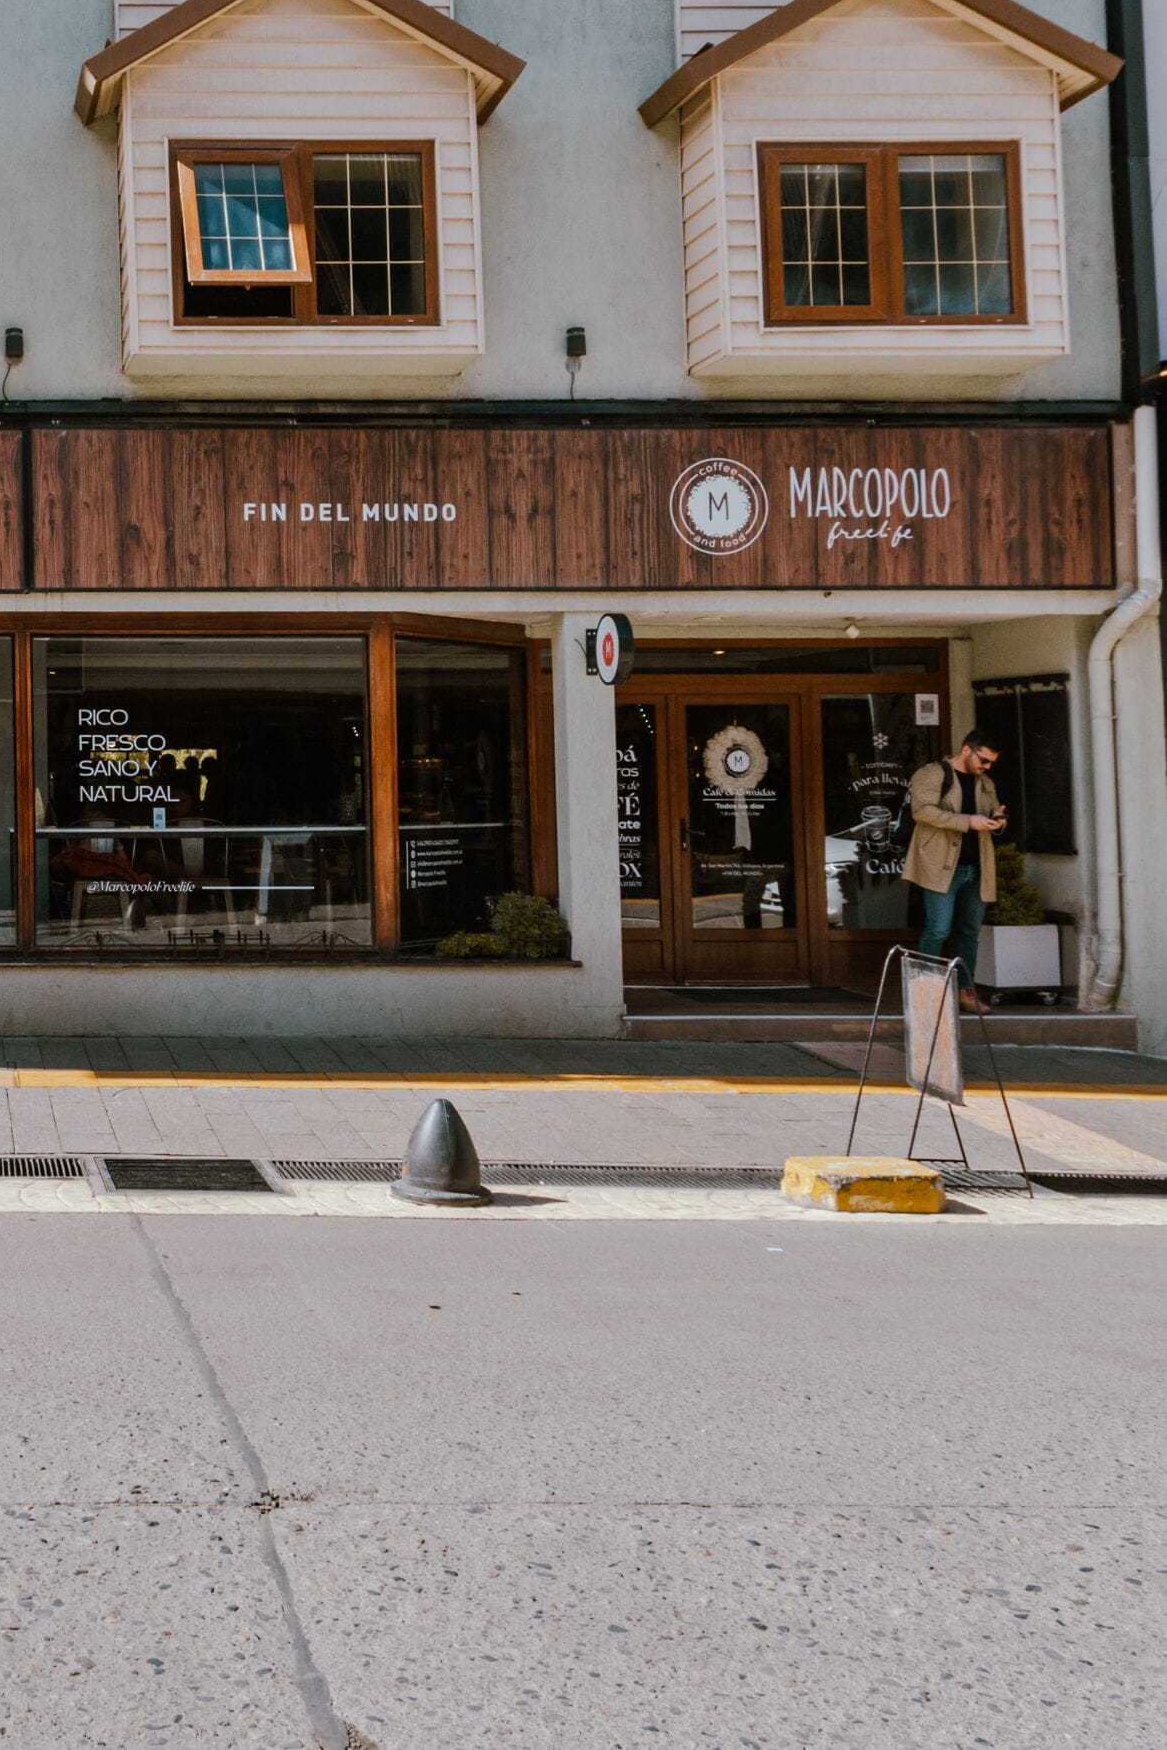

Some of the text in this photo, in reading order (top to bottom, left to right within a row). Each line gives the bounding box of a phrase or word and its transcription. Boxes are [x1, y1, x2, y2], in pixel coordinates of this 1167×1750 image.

[698, 461, 739, 476] coffee
[789, 466, 951, 518] MARCOPOLO
[243, 503, 457, 522] FIN DEL MUNDO
[709, 491, 729, 521] M
[693, 533, 746, 548] and food
[78, 709, 129, 726] RICO
[78, 734, 166, 751] FRESCO
[79, 760, 157, 777] SANO Y
[734, 755, 743, 766] M
[852, 776, 880, 791] para
[80, 785, 180, 802] NATURAL
